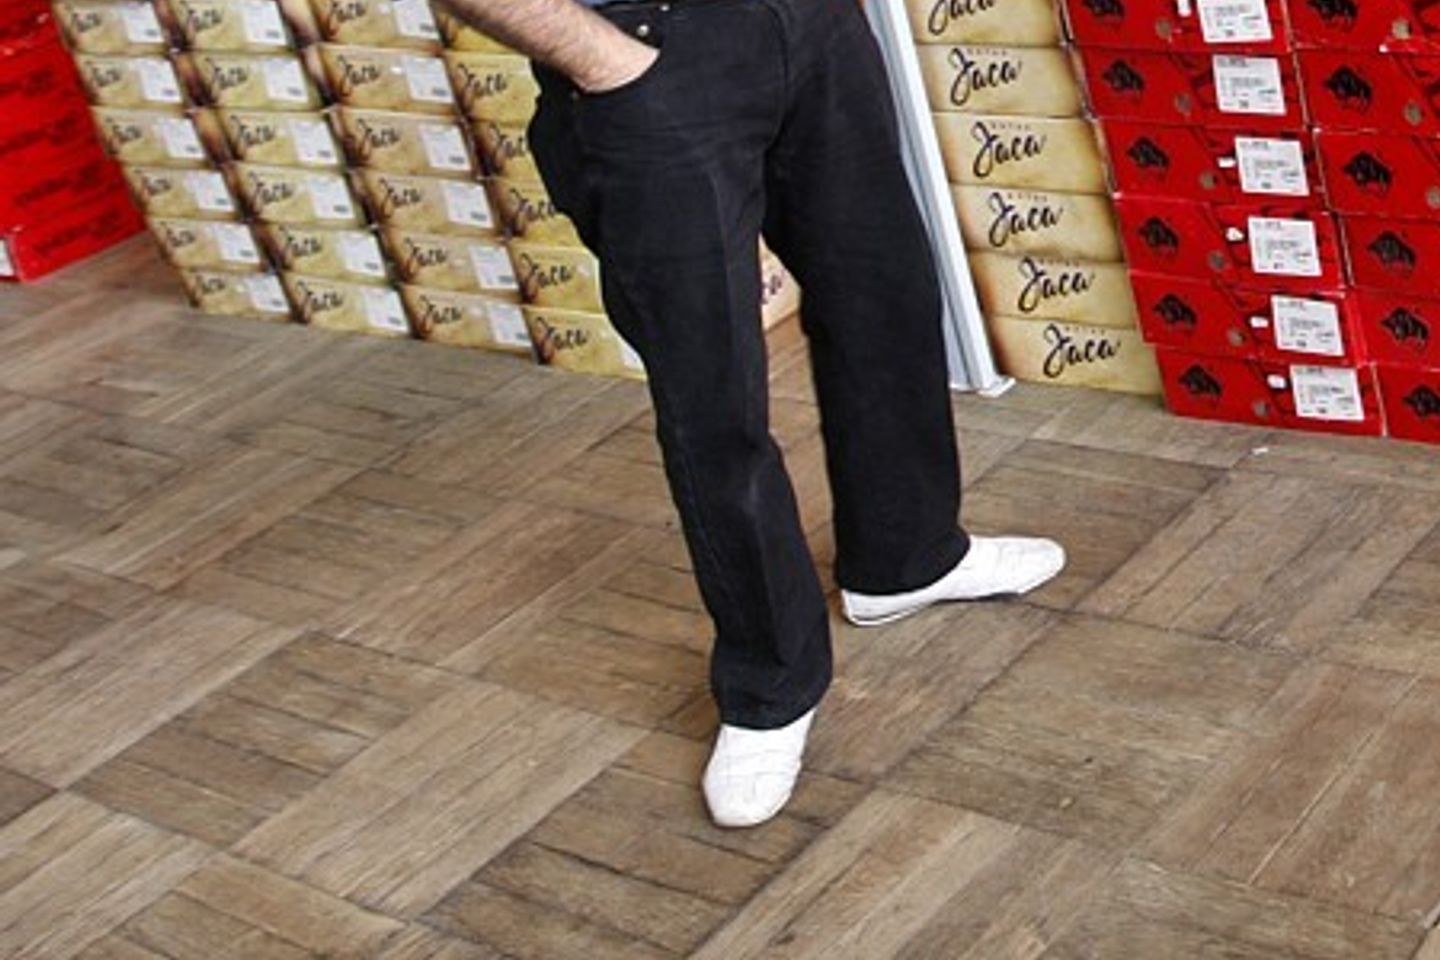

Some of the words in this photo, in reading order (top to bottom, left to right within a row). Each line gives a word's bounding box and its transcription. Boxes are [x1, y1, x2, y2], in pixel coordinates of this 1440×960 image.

[948, 46, 1023, 107] Jaca
[970, 120, 1047, 179] Jaca
[987, 191, 1064, 248] Jaca
[1018, 256, 1095, 314] Jaca
[1043, 322, 1122, 379] Jaca
